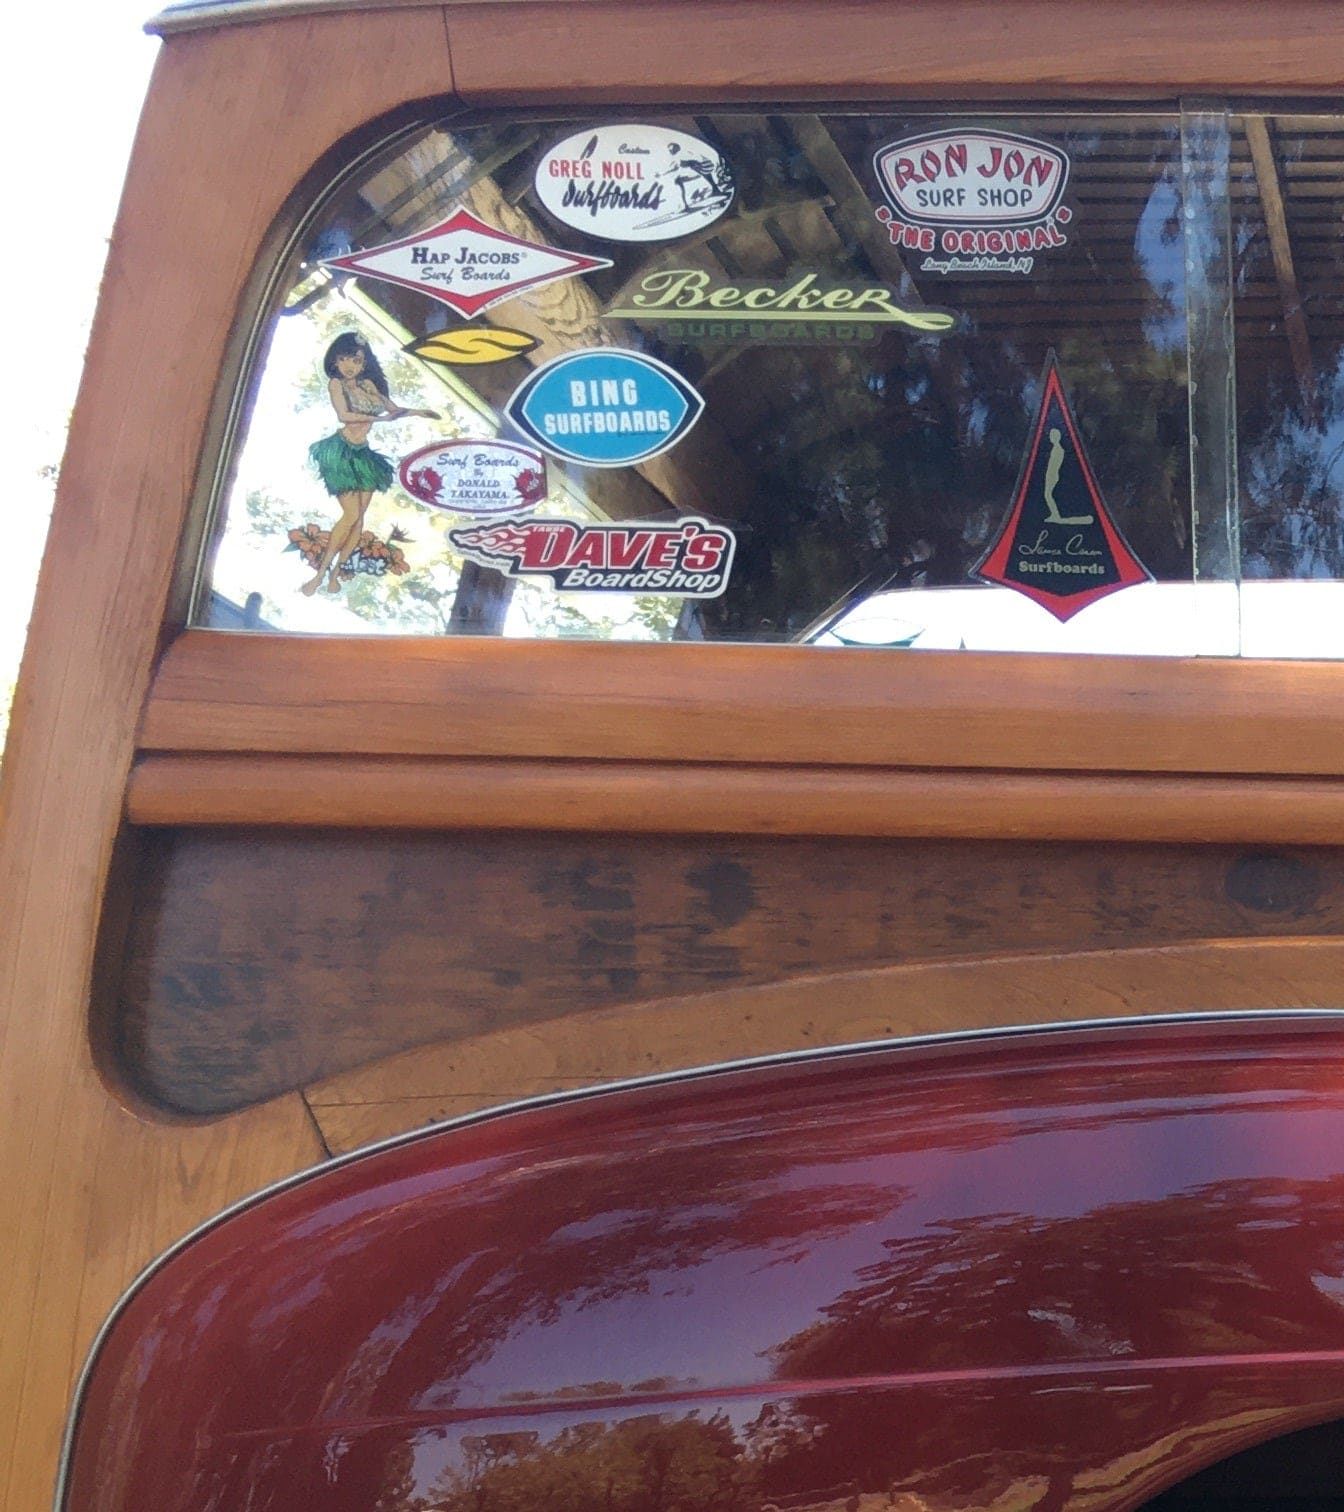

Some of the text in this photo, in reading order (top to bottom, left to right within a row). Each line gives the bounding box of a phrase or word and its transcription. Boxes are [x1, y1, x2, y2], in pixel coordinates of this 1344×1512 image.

[549, 160, 645, 180] GREG NOLL
[894, 143, 1054, 190] RON JON
[915, 188, 1033, 207] SURF SHOP
[420, 266, 511, 285] Surf Boards
[570, 378, 638, 407] BING
[544, 409, 671, 435] SURFBOARDS
[436, 453, 520, 469] Surf Boards
[457, 479, 501, 488] DONALD
[518, 524, 727, 573] DAVE'S
[1018, 561, 1106, 575] Surfboards
[562, 568, 722, 593] BoardShop
